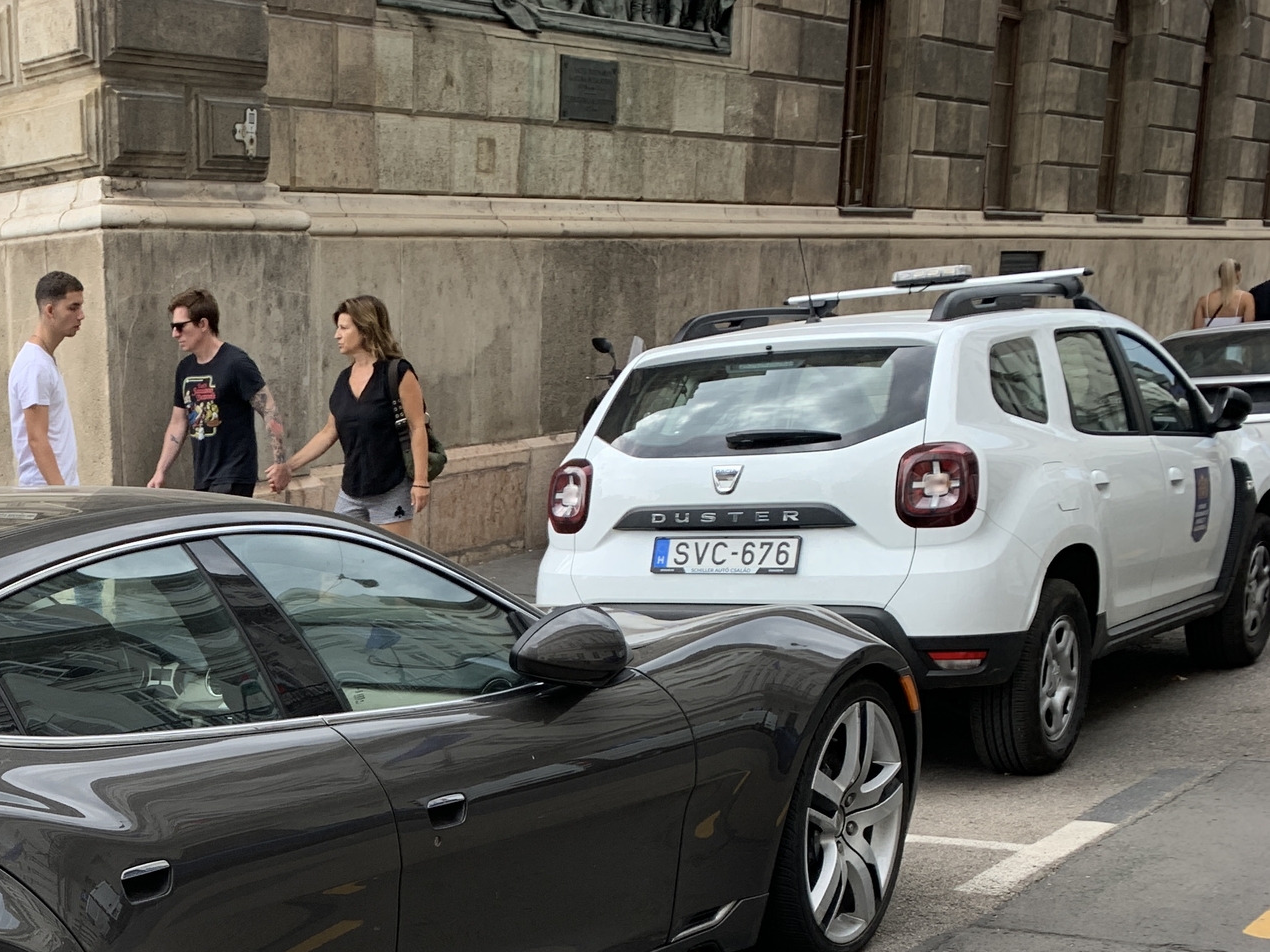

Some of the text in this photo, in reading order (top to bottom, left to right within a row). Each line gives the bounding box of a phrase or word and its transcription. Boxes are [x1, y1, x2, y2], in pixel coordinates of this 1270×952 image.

[651, 510, 800, 524] DUSTER
[656, 541, 791, 566] H SVC-676
